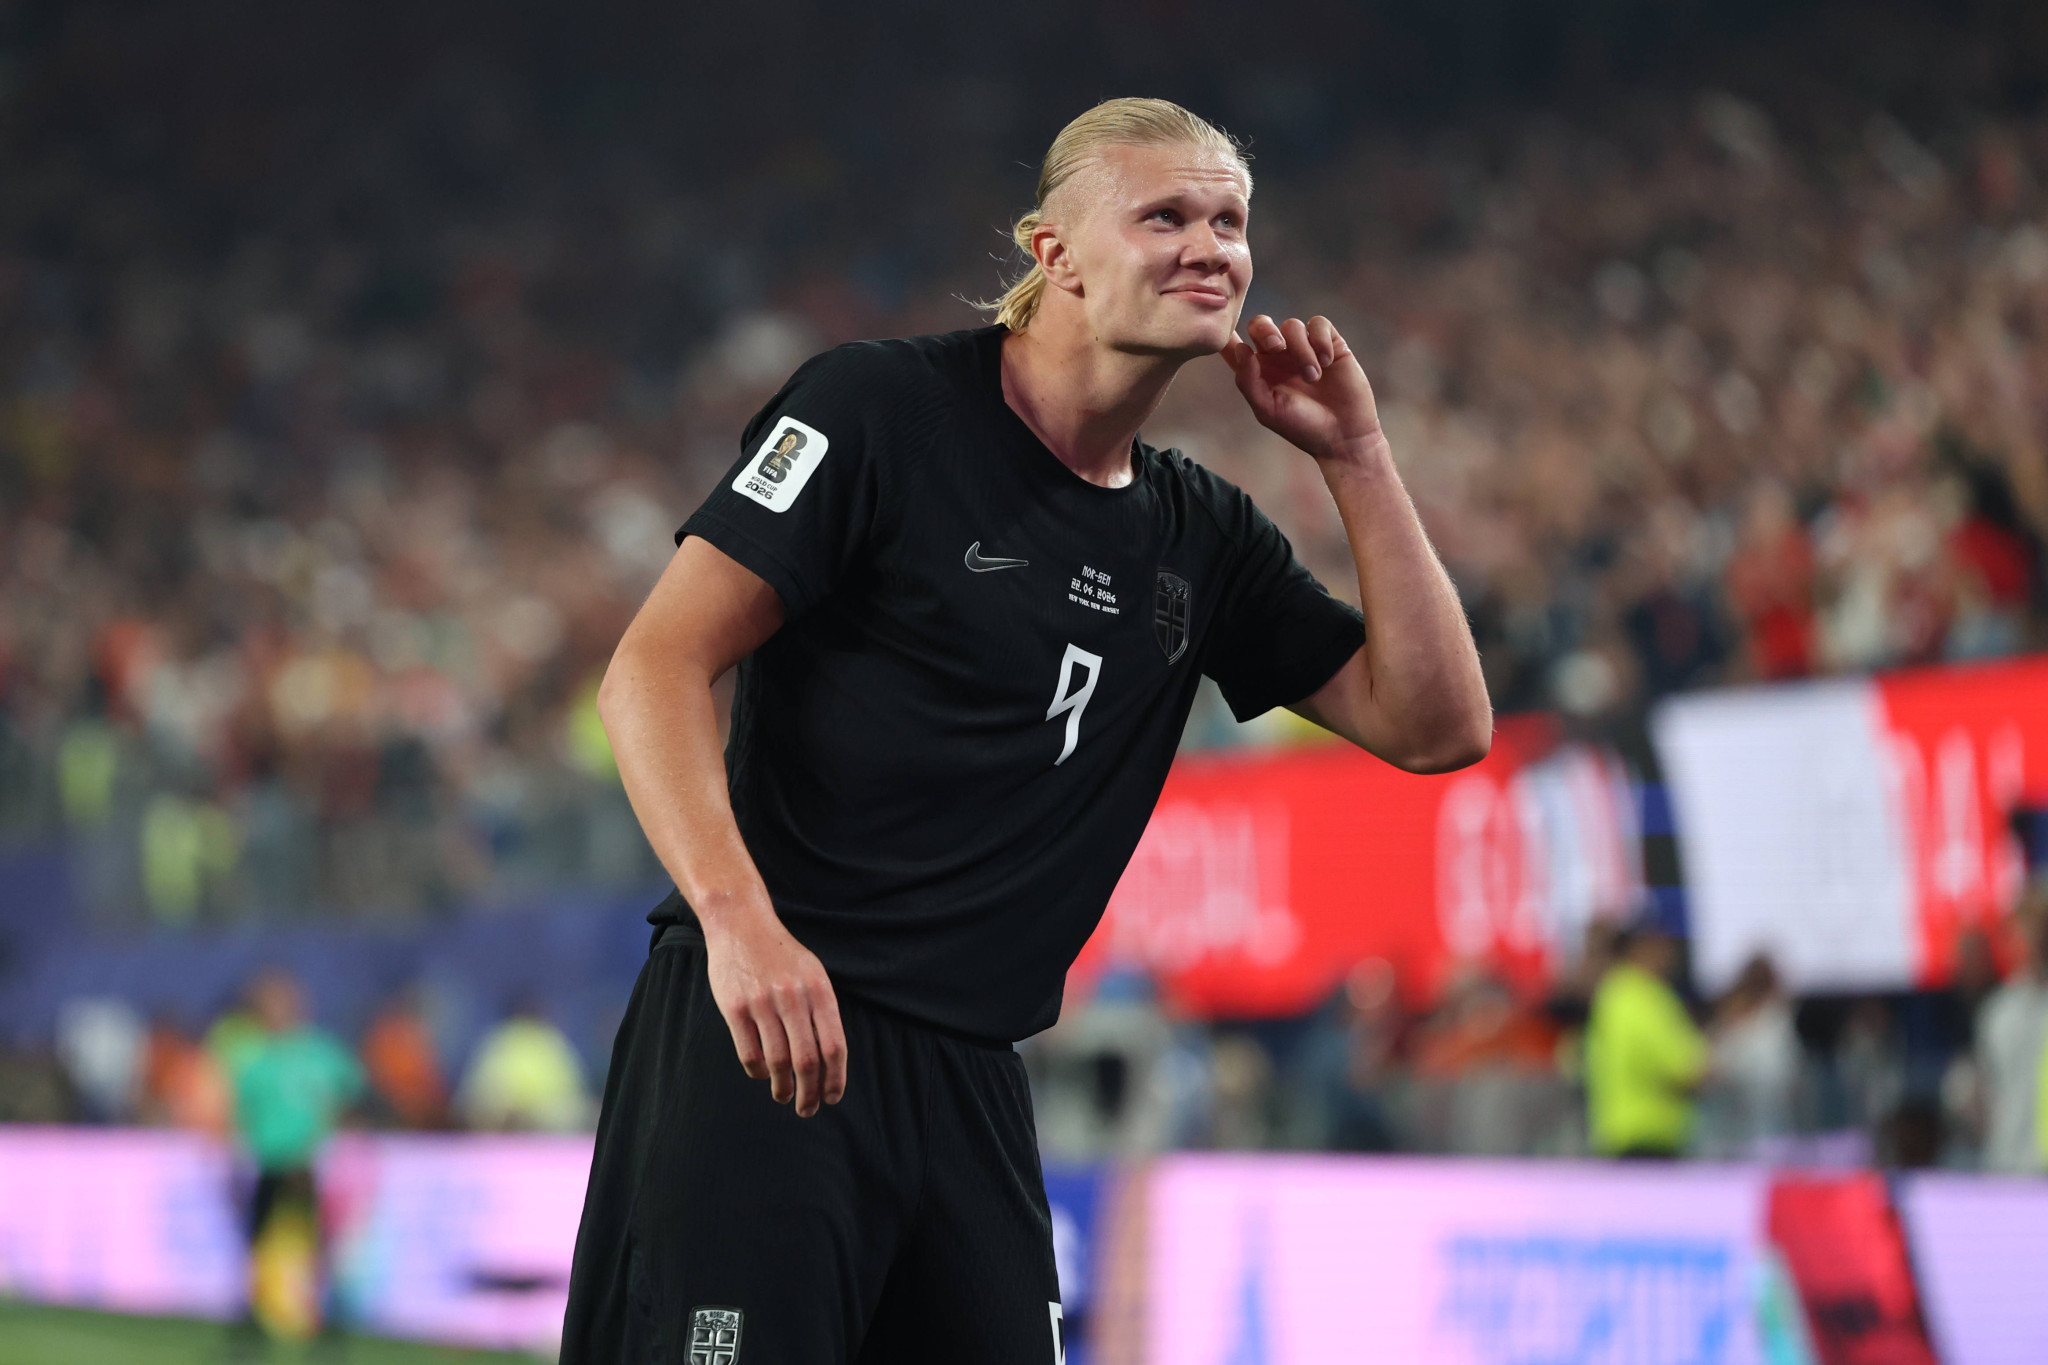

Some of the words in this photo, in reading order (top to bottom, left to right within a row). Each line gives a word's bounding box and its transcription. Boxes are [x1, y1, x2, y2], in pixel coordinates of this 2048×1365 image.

[763, 466, 778, 478] FIFA
[745, 481, 773, 500] 2026
[751, 475, 767, 486] WORLD
[766, 483, 778, 492] CUP
[1082, 565, 1111, 586] NOR-SEN
[1090, 602, 1100, 610] NEW
[1045, 642, 1103, 766] 9
